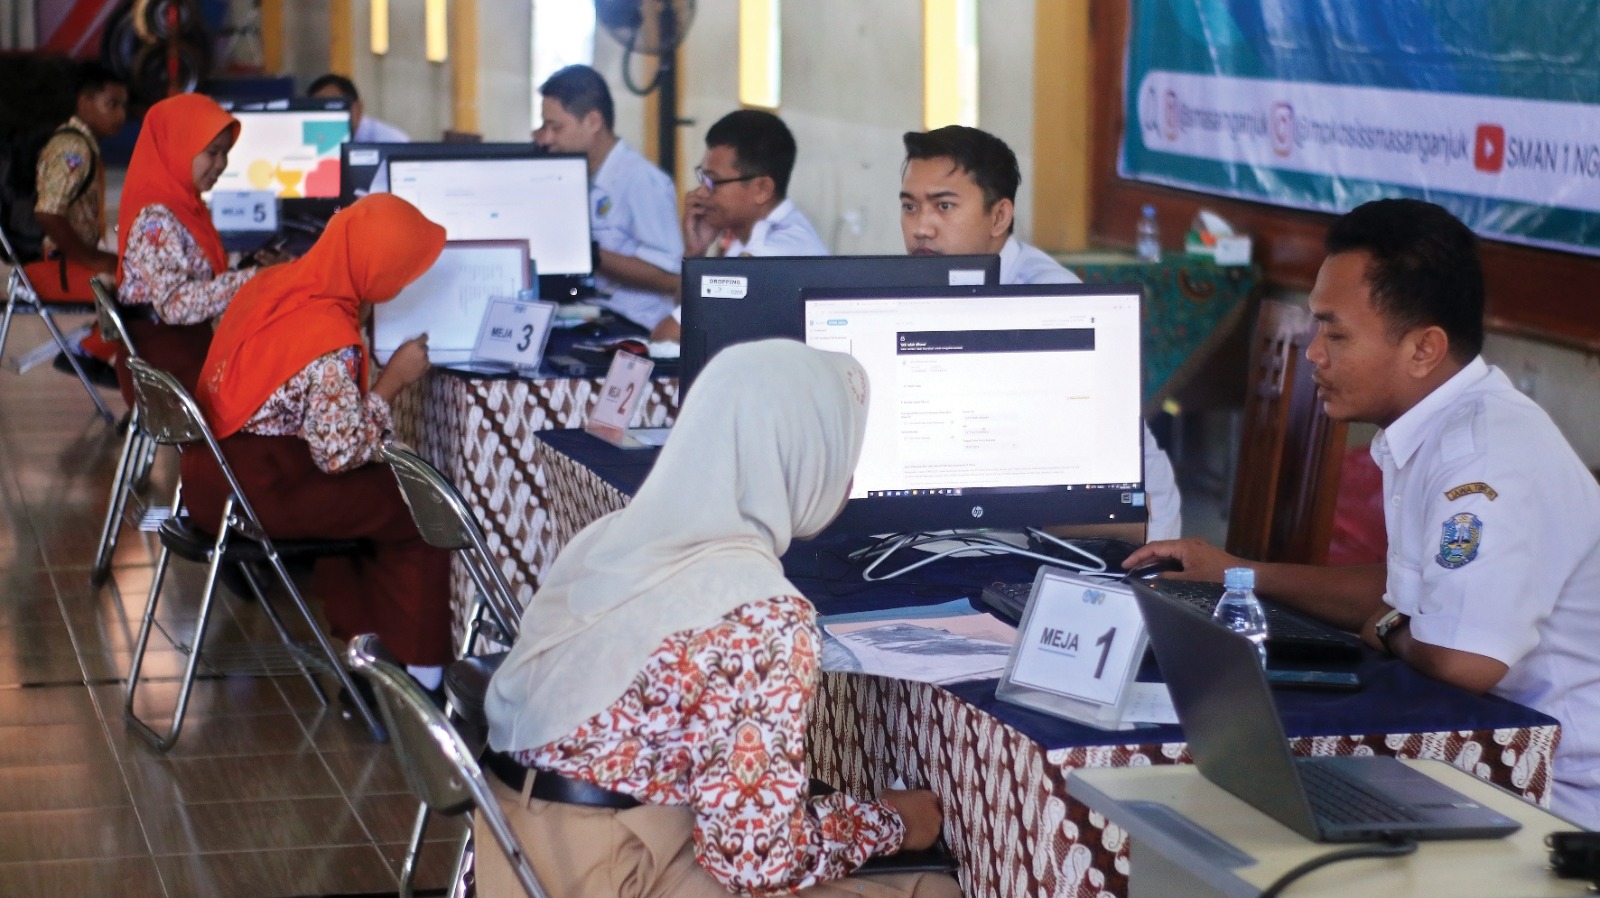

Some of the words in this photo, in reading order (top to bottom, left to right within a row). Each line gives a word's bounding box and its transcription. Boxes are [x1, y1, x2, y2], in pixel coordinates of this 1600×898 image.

[1507, 136, 1557, 173] SMAN
[1563, 143, 1570, 175] 1
[1573, 144, 1600, 178] NG
[253, 202, 267, 223] 5
[491, 327, 512, 339] MEJA
[517, 324, 534, 352] 3
[617, 382, 635, 415] 2
[971, 506, 984, 518] hp
[1040, 627, 1079, 651] MEJA
[1094, 626, 1117, 680] 1
